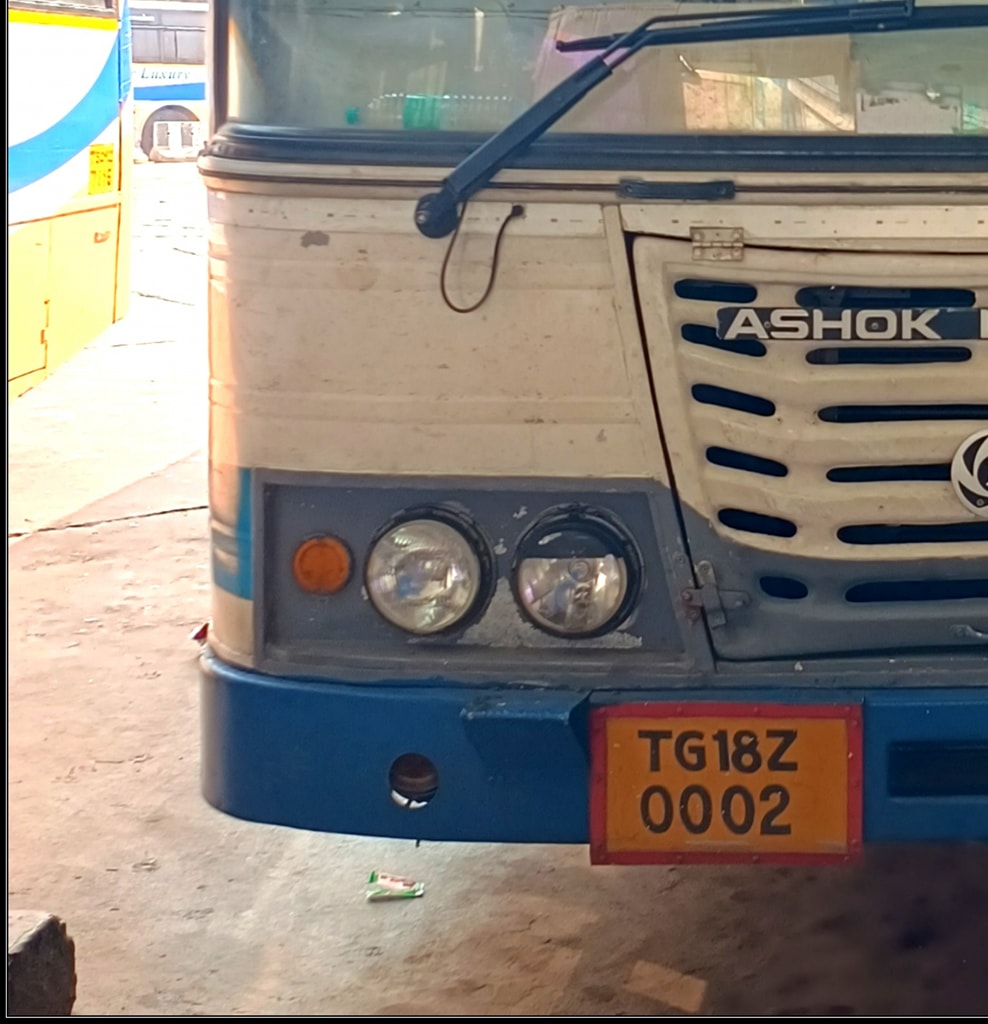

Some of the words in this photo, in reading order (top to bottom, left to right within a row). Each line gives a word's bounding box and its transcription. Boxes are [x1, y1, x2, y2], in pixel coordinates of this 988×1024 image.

[723, 307, 941, 341] ASHOK
[638, 729, 798, 773] TG18Z
[640, 784, 792, 836] 0002
